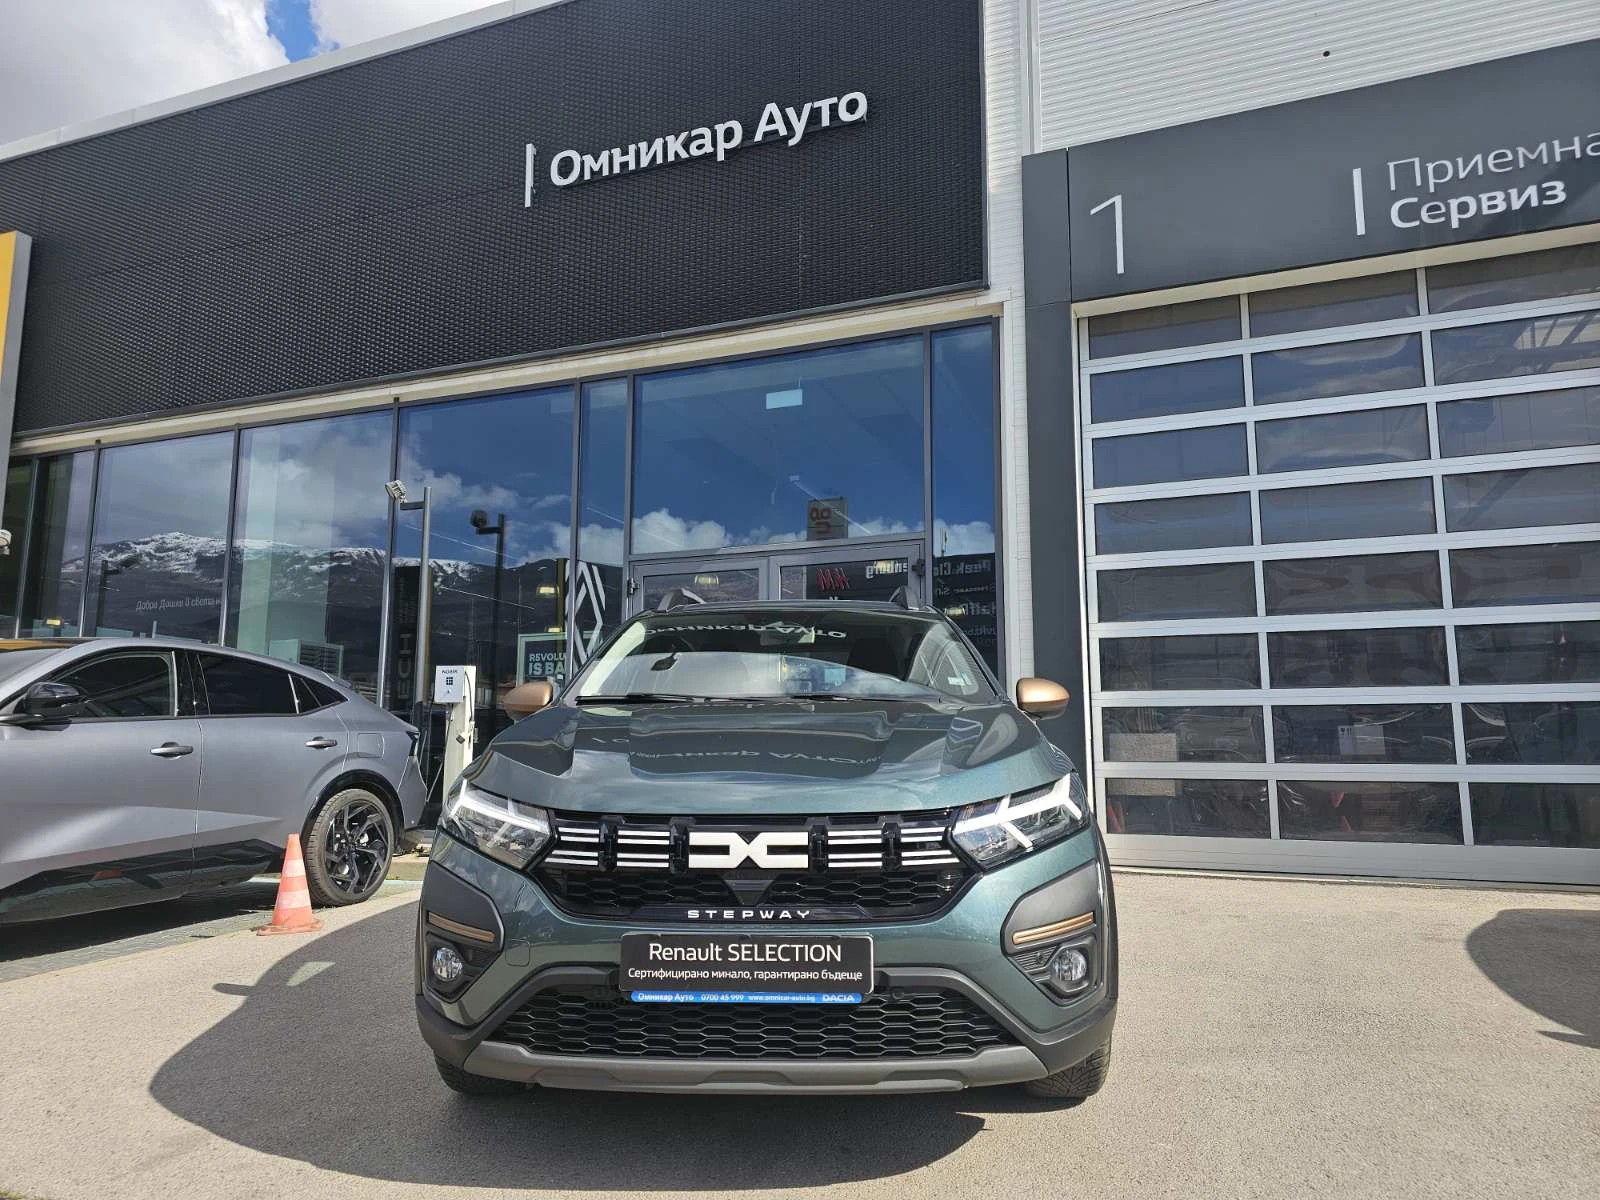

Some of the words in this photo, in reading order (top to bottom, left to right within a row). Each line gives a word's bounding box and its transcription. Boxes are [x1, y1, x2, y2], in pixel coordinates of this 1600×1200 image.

[550, 119, 743, 187] Омникар
[753, 91, 868, 146] Ауто
[1387, 131, 1600, 193] Приемна
[1390, 180, 1567, 229] Сервиз
[1089, 193, 1125, 274] 1
[529, 662, 543, 676] IS
[687, 909, 810, 919] STEPWAY
[649, 943, 723, 963] Renault
[727, 944, 842, 963] SELECTION
[628, 967, 710, 981] Сертифицирано
[711, 970, 752, 980] минало,
[753, 970, 819, 981] гарантирано
[821, 969, 863, 982] бъдеще
[638, 992, 674, 1002] Омникар
[674, 992, 694, 1003] Ауто
[700, 993, 719, 1001] 0700
[731, 993, 745, 1001] 999
[822, 994, 855, 1003] DACIA
